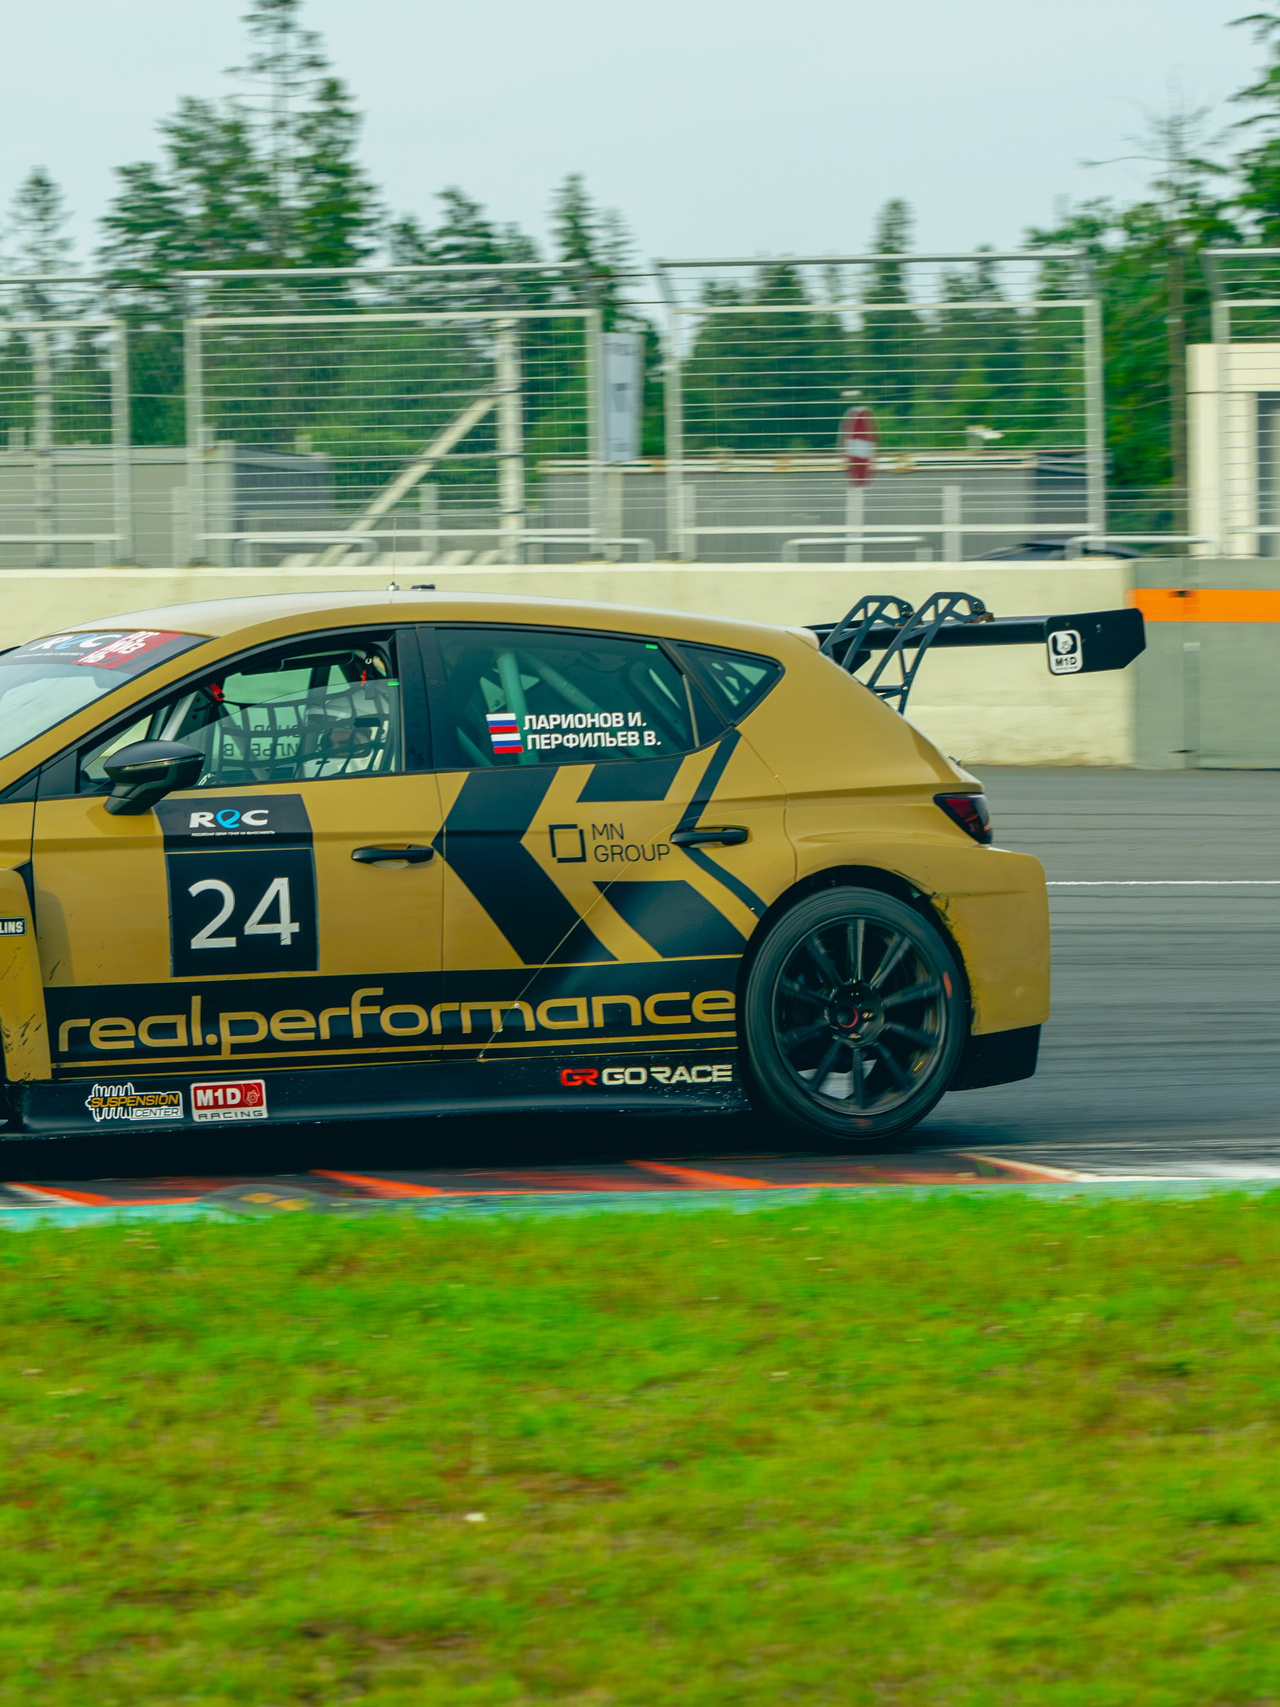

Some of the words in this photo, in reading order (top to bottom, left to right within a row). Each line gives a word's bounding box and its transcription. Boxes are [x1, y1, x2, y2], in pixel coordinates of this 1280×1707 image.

[1055, 656, 1077, 667] M1D
[523, 712, 624, 731] ЛАРИОНОВ
[627, 711, 647, 727] И.
[527, 731, 640, 750] ПЕРФИЛЬЕВ
[643, 730, 662, 746] В.
[592, 823, 624, 840] MN
[594, 843, 670, 863] GROUP
[187, 877, 300, 949] 24
[58, 987, 736, 1057] real.performance
[601, 1066, 648, 1086] GO
[650, 1064, 733, 1084] RACE
[90, 1093, 180, 1109] SUSPENSION
[196, 1087, 242, 1107] M1D
[134, 1107, 180, 1118] CENTER
[198, 1109, 264, 1120] RACING
